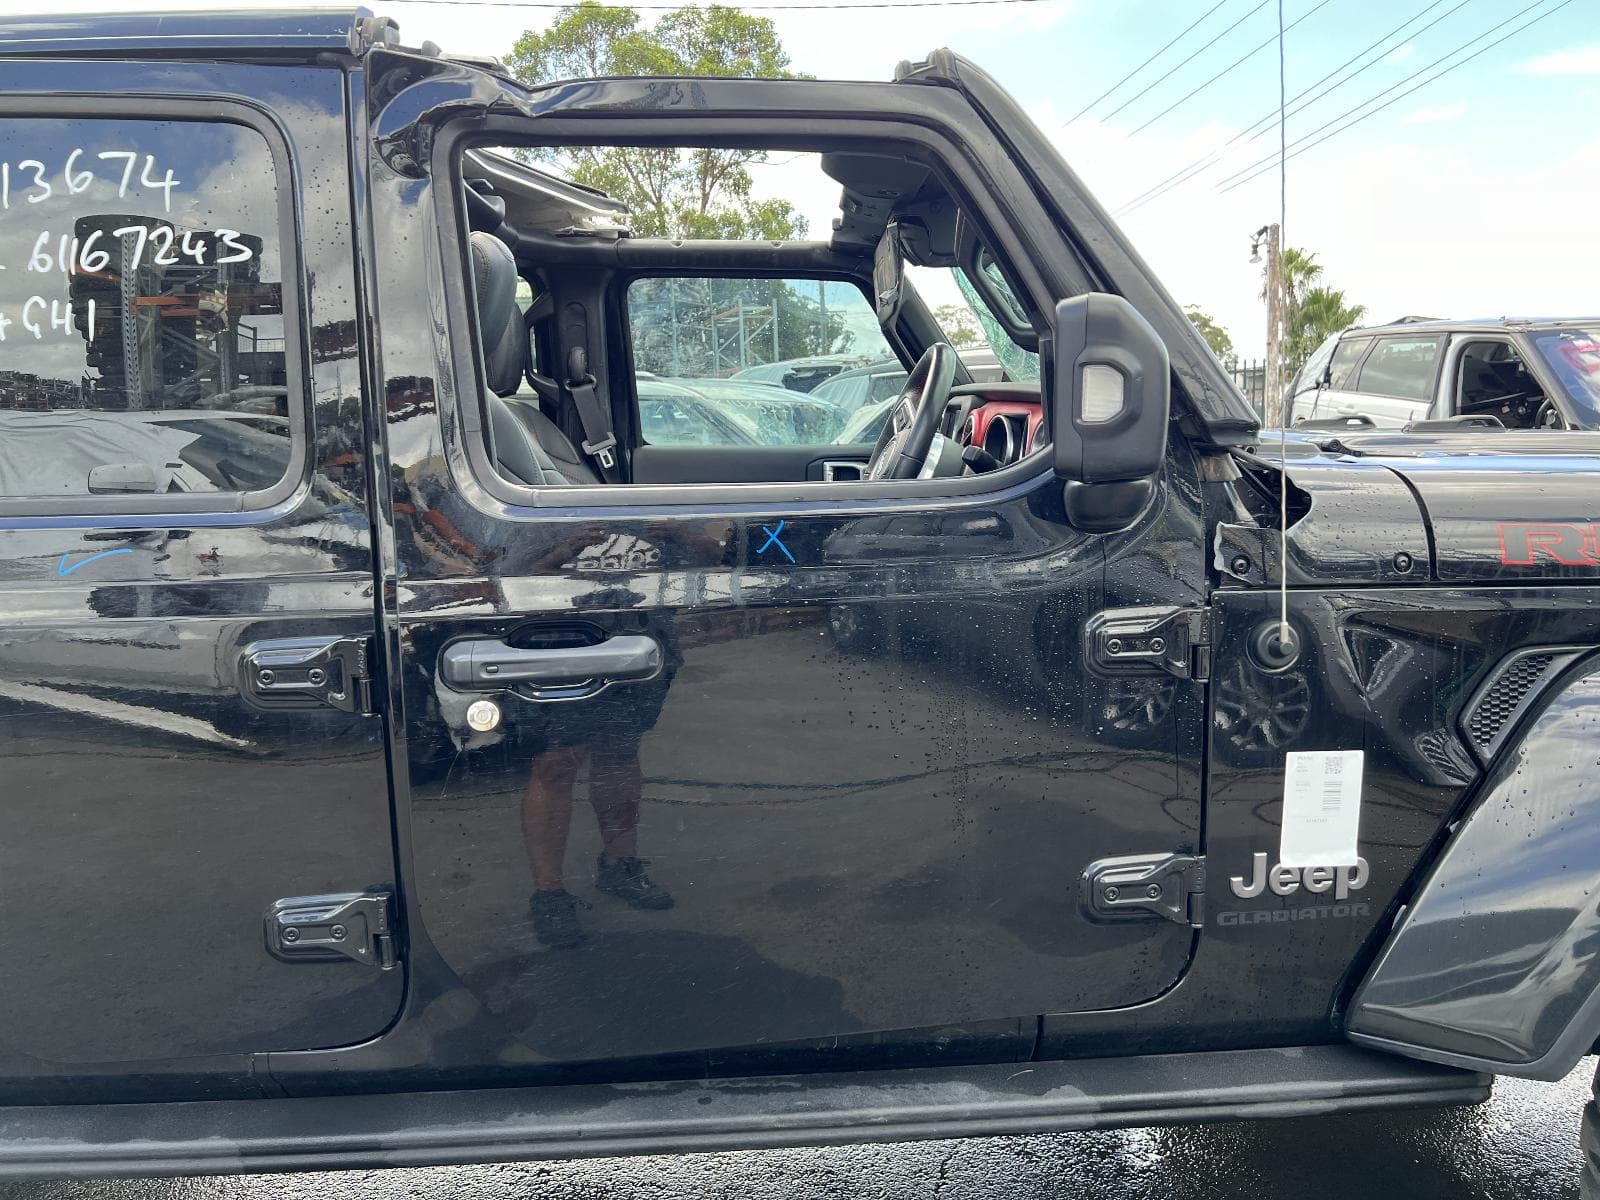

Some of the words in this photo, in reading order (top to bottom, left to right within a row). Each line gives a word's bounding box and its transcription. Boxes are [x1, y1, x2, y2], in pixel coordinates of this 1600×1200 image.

[2, 149, 181, 212] 13674
[1496, 522, 1600, 565] R
[1230, 852, 1370, 900] Jeep
[1216, 903, 1371, 926] GLADIATOR
